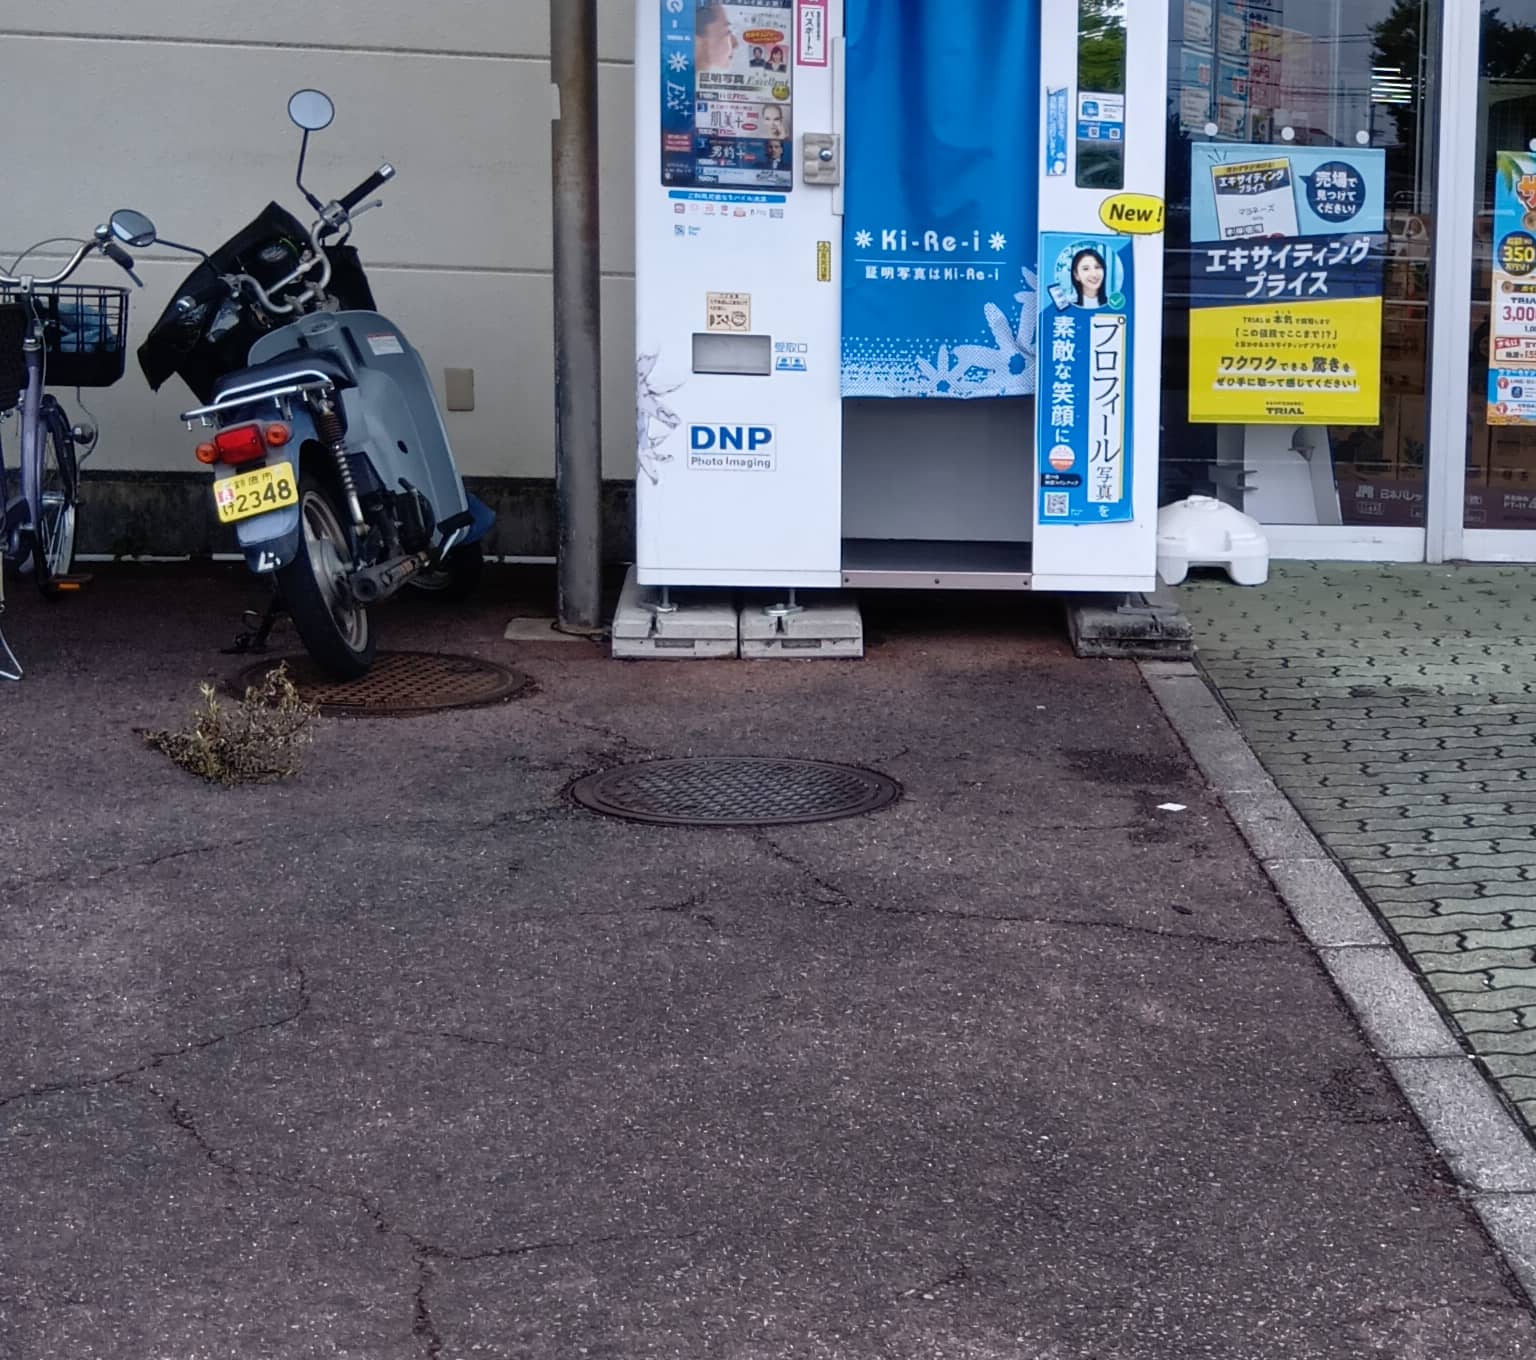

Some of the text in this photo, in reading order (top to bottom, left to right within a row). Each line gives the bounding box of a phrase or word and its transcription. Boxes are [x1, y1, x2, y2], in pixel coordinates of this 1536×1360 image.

[1316, 171, 1358, 188] 売場で
[1316, 190, 1356, 202] 見つけて
[881, 229, 980, 252] Ki-Re-i
[1206, 237, 1370, 272] エキサイティング
[1503, 245, 1536, 262] 350
[1246, 271, 1328, 298] プライス
[1051, 315, 1076, 443] 素敵な笑顔に
[1266, 407, 1304, 415] TRIAL
[691, 426, 772, 450] DNP
[691, 456, 771, 468] Photo Imaging
[235, 478, 292, 513] 2348
